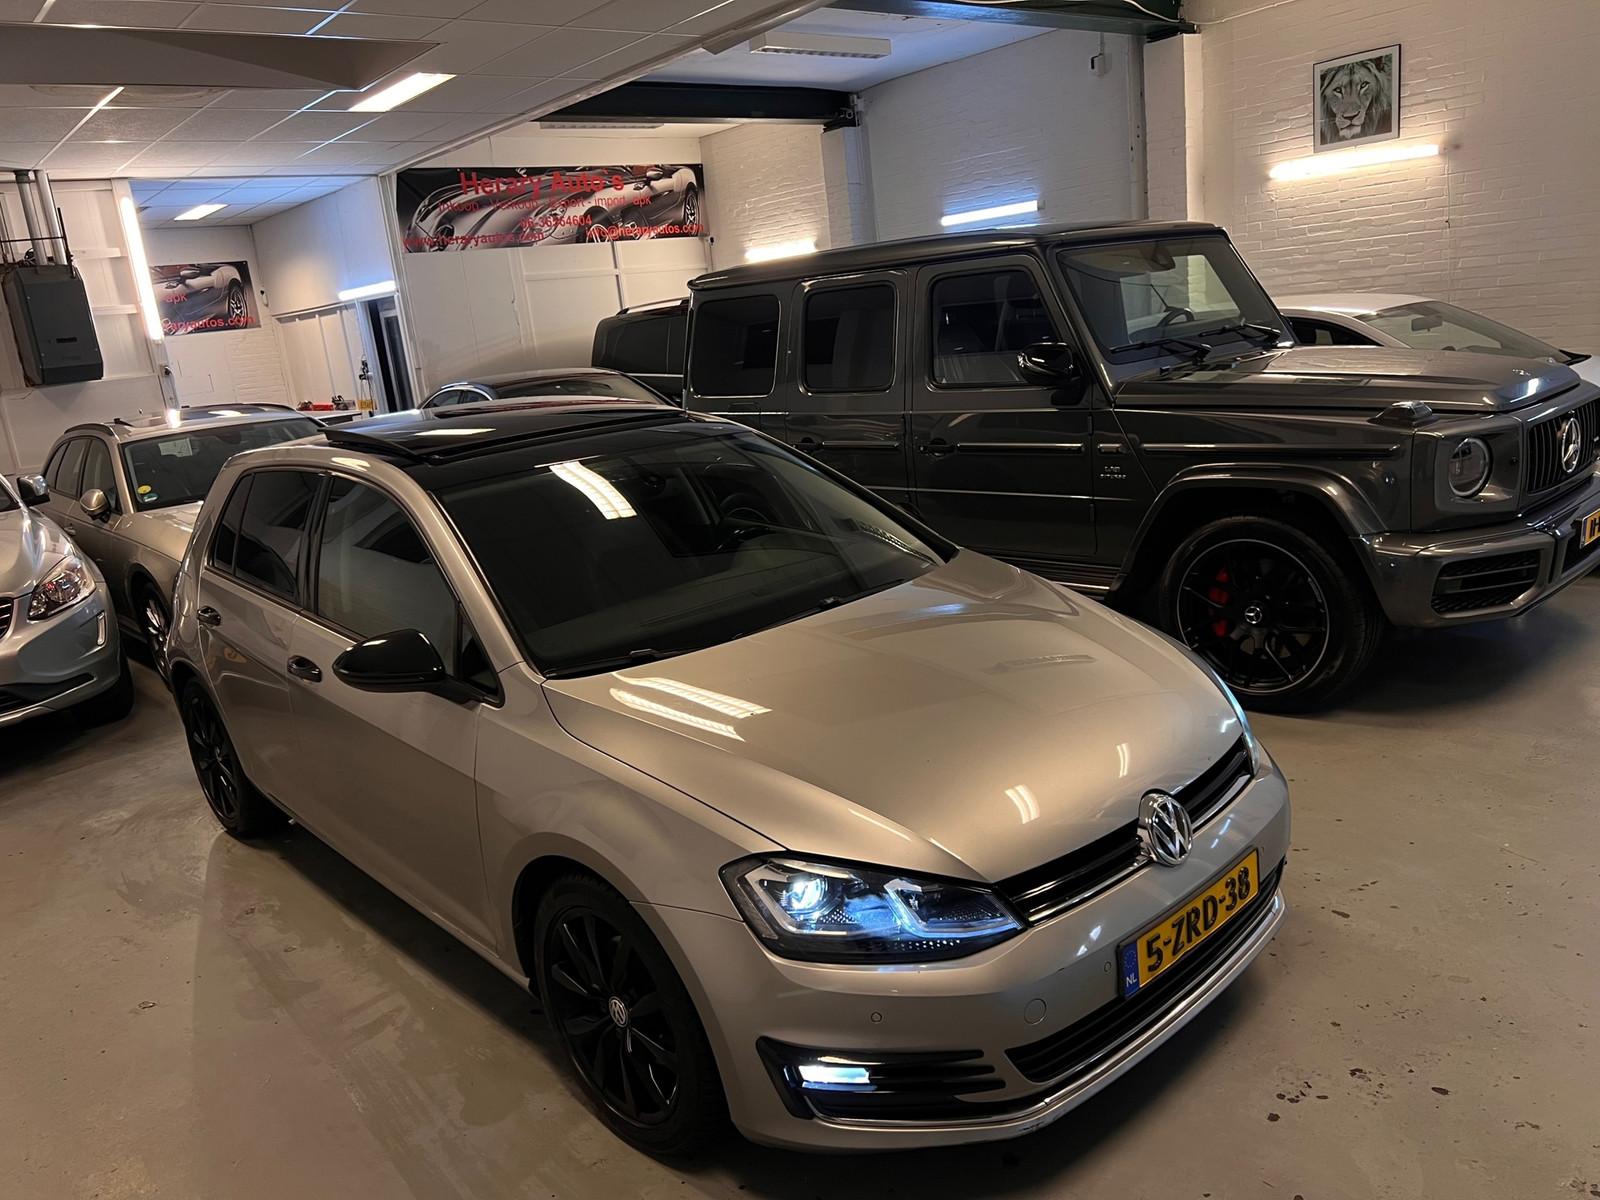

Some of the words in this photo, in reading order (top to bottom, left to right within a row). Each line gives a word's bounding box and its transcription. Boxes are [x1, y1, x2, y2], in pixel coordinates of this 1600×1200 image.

[460, 171, 542, 200] Herary
[1146, 866, 1251, 973] 5-ZRD-38
[1125, 973, 1138, 988] NL
